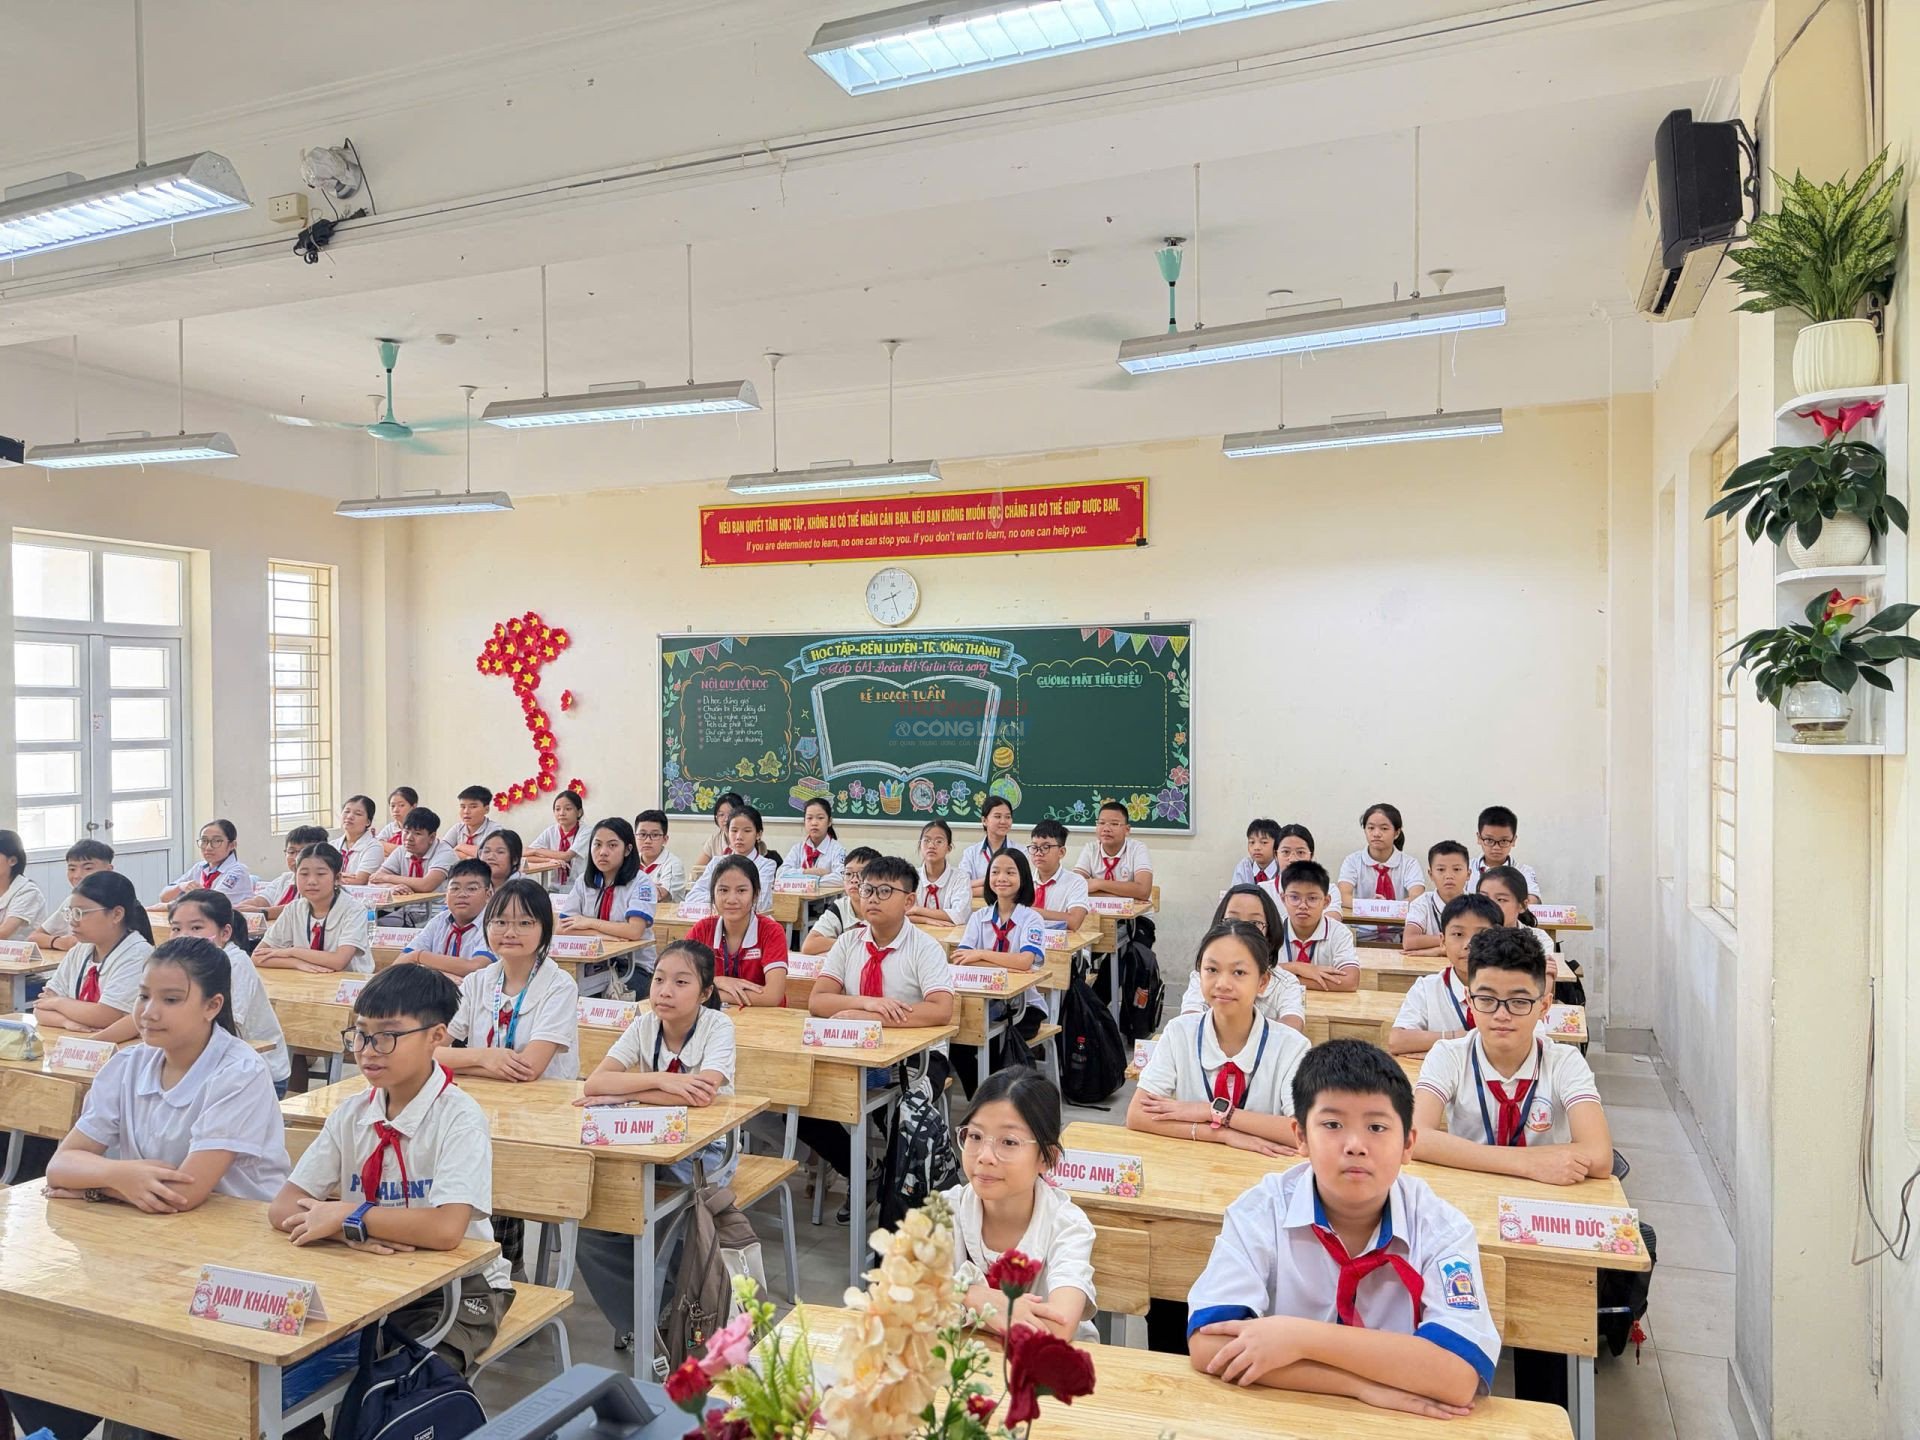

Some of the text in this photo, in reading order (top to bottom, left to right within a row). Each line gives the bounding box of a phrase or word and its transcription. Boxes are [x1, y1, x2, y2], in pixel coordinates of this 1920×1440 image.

[719, 518, 731, 534] NẾU
[732, 522, 744, 536] BẠN
[746, 517, 764, 534] QUYẾT
[766, 519, 778, 532] TÂM
[779, 520, 791, 533] HỌC
[808, 517, 829, 530] KHÔNG
[830, 518, 836, 528] AI
[838, 514, 846, 528] CÓ
[848, 510, 860, 528] THỂ
[895, 513, 910, 528] BẠN.
[912, 506, 924, 524] NẾU
[926, 509, 940, 526] BẠN
[942, 504, 964, 522] KHÔNG
[966, 501, 986, 520] MUỐN
[1030, 504, 1037, 517] AI
[1038, 501, 1048, 517] CÓ
[1050, 496, 1063, 515] THỂ
[1064, 499, 1080, 515] GIÚP
[1082, 498, 1102, 516] ĐƯỢC
[1103, 498, 1120, 516] BẠN.
[746, 542, 752, 552] If
[752, 543, 764, 553] you
[765, 542, 776, 550] are
[776, 538, 813, 550] determined
[814, 539, 820, 548] to
[822, 538, 840, 549] learn,
[842, 539, 850, 547] no
[852, 538, 864, 546] one
[865, 537, 878, 546] can
[879, 535, 894, 547] stop
[896, 535, 912, 547] you.
[913, 533, 919, 543] If
[920, 533, 934, 545] you
[956, 531, 976, 541] want
[976, 530, 984, 540] to
[986, 529, 1006, 540] learn,
[1008, 530, 1019, 538] no
[1020, 529, 1035, 538] one
[1036, 528, 1050, 537] can
[1052, 525, 1070, 538] help
[1072, 525, 1088, 537] you.
[810, 647, 834, 662] HỌC
[966, 642, 1000, 658] THÀNH
[720, 679, 736, 689] QUY
[737, 676, 751, 689] LỚP
[752, 679, 769, 690] HỌC
[1036, 674, 1070, 686] GƯƠNG
[955, 972, 978, 982] KHÁNH
[590, 1008, 604, 1018] ANH
[824, 1028, 858, 1040] MAI ANH
[630, 1120, 654, 1134] ANH
[1054, 1162, 1114, 1183] NGỌC ANH
[1531, 1215, 1605, 1238] MINH ĐỨC
[213, 1285, 288, 1316] NAM KHÁNH
